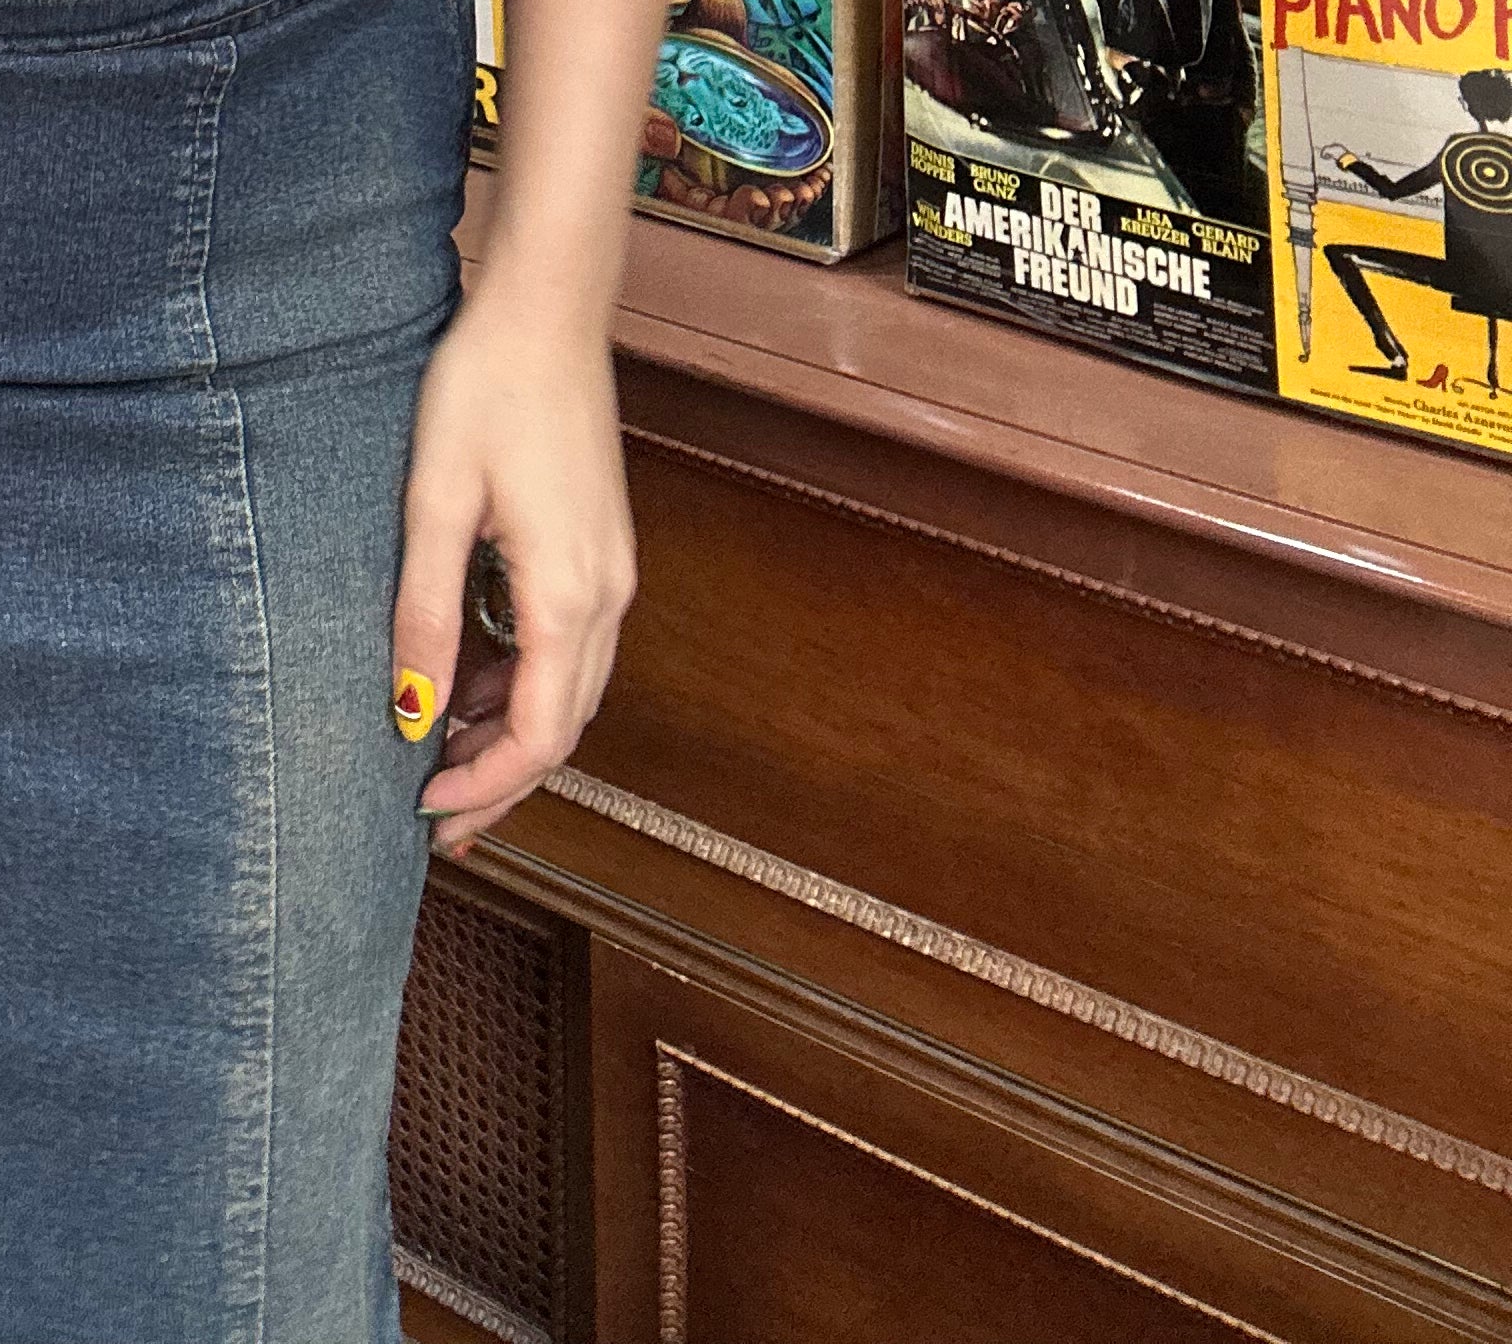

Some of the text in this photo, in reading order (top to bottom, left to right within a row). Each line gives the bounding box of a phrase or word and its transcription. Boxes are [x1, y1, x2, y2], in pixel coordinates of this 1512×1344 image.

[474, 66, 500, 125] R
[910, 140, 955, 171] DENNIS
[910, 152, 956, 185] HOPPER
[969, 162, 1021, 189] BRUNO
[973, 177, 1017, 202] GANZ
[1039, 180, 1103, 233] DER
[1136, 207, 1174, 230] LISA
[943, 191, 1212, 301] AMERIKANISCHE
[1120, 215, 1191, 248] KREUZER
[1191, 221, 1261, 252] GERARD
[1201, 238, 1253, 265] BLAIN
[1012, 246, 1139, 318] FREUND
